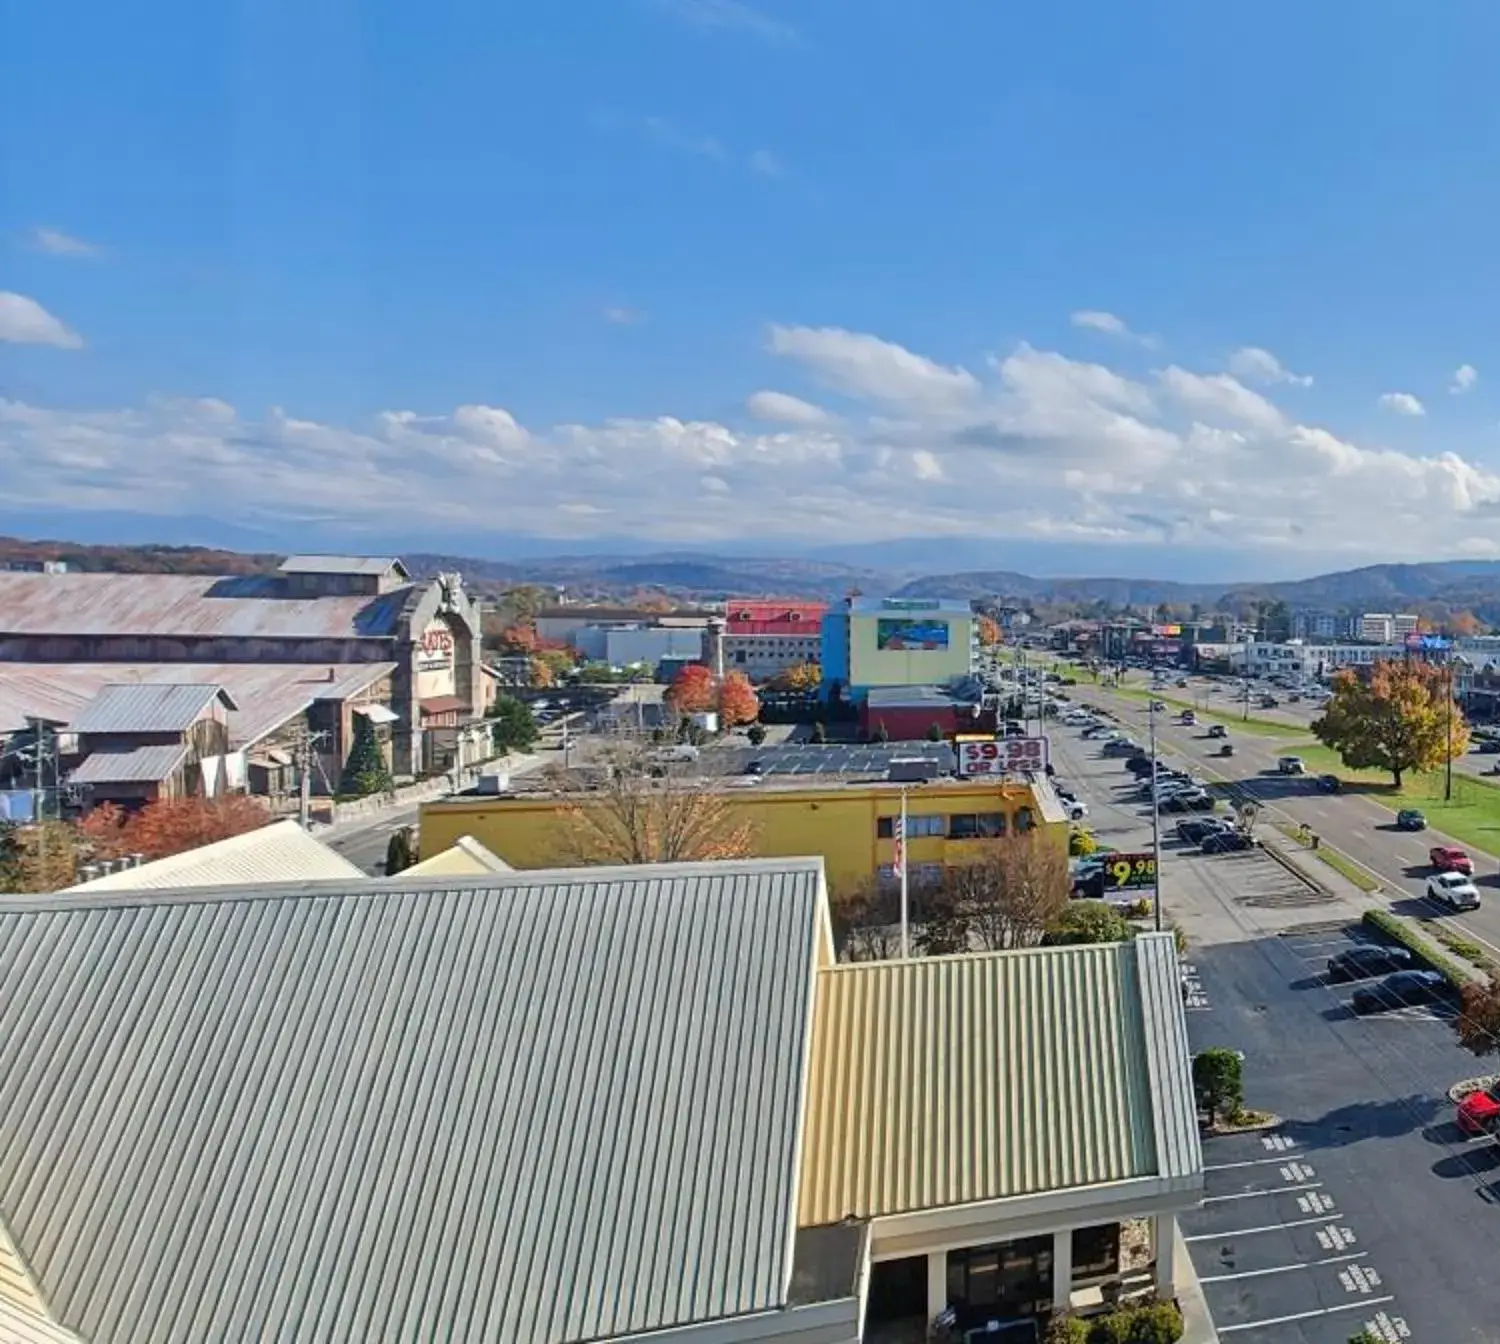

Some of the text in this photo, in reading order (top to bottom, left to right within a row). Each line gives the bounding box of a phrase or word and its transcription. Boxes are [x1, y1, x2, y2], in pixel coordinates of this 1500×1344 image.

[965, 741, 1041, 760] $9.98
[966, 759, 1042, 773] OR LESS
[1105, 859, 1156, 887] $9.98
